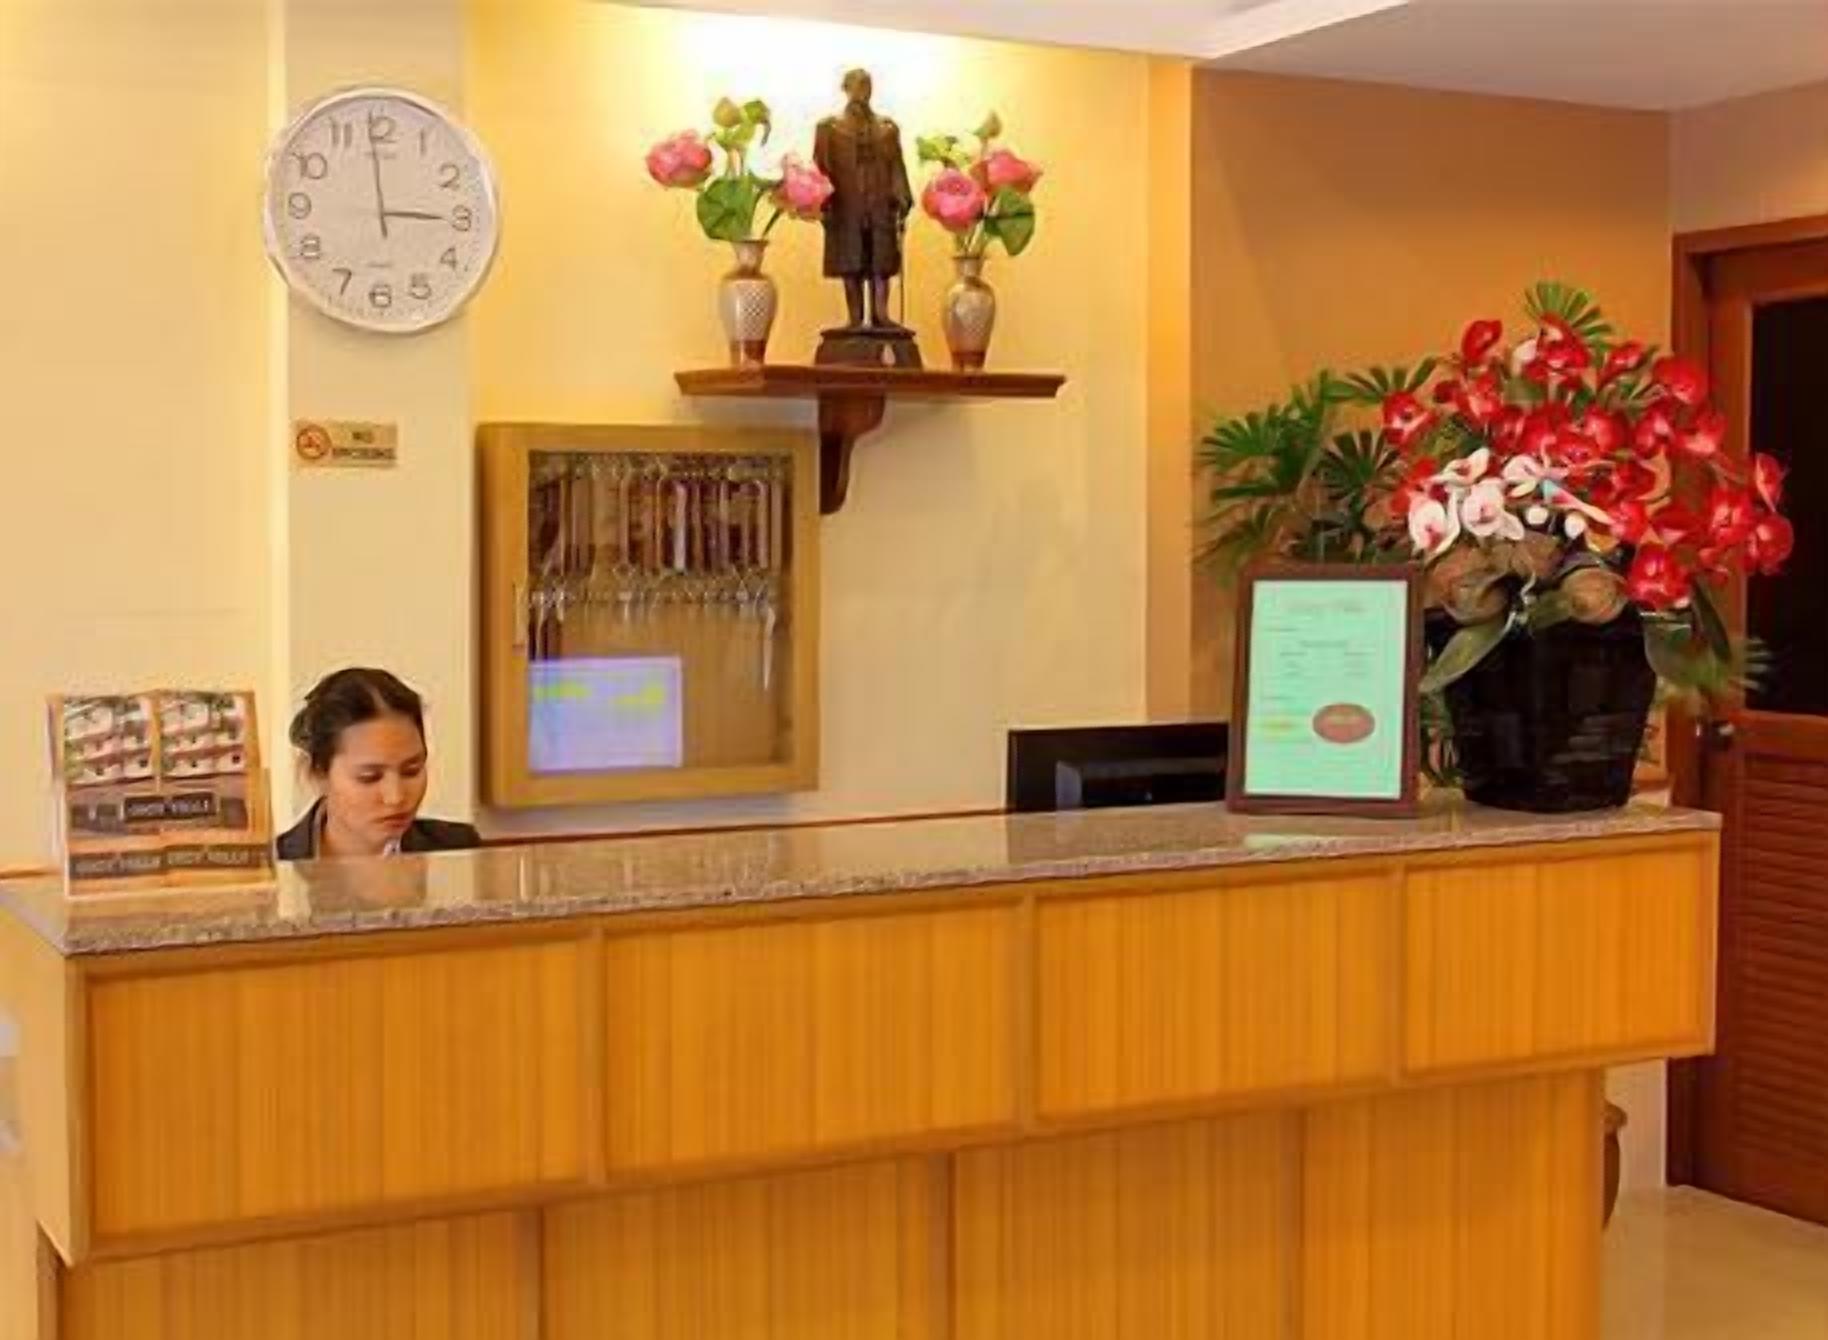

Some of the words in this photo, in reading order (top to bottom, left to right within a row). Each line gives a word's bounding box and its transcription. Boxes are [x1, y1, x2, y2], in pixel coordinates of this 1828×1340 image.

[330, 120, 352, 148] 11
[292, 152, 328, 180] 10
[440, 163, 460, 190] 2
[288, 192, 311, 220] 9
[452, 205, 472, 232] 3
[300, 234, 320, 260] 8
[440, 247, 458, 272] 4
[333, 267, 353, 296] 7
[410, 273, 431, 300] 5
[369, 284, 392, 308] 6
